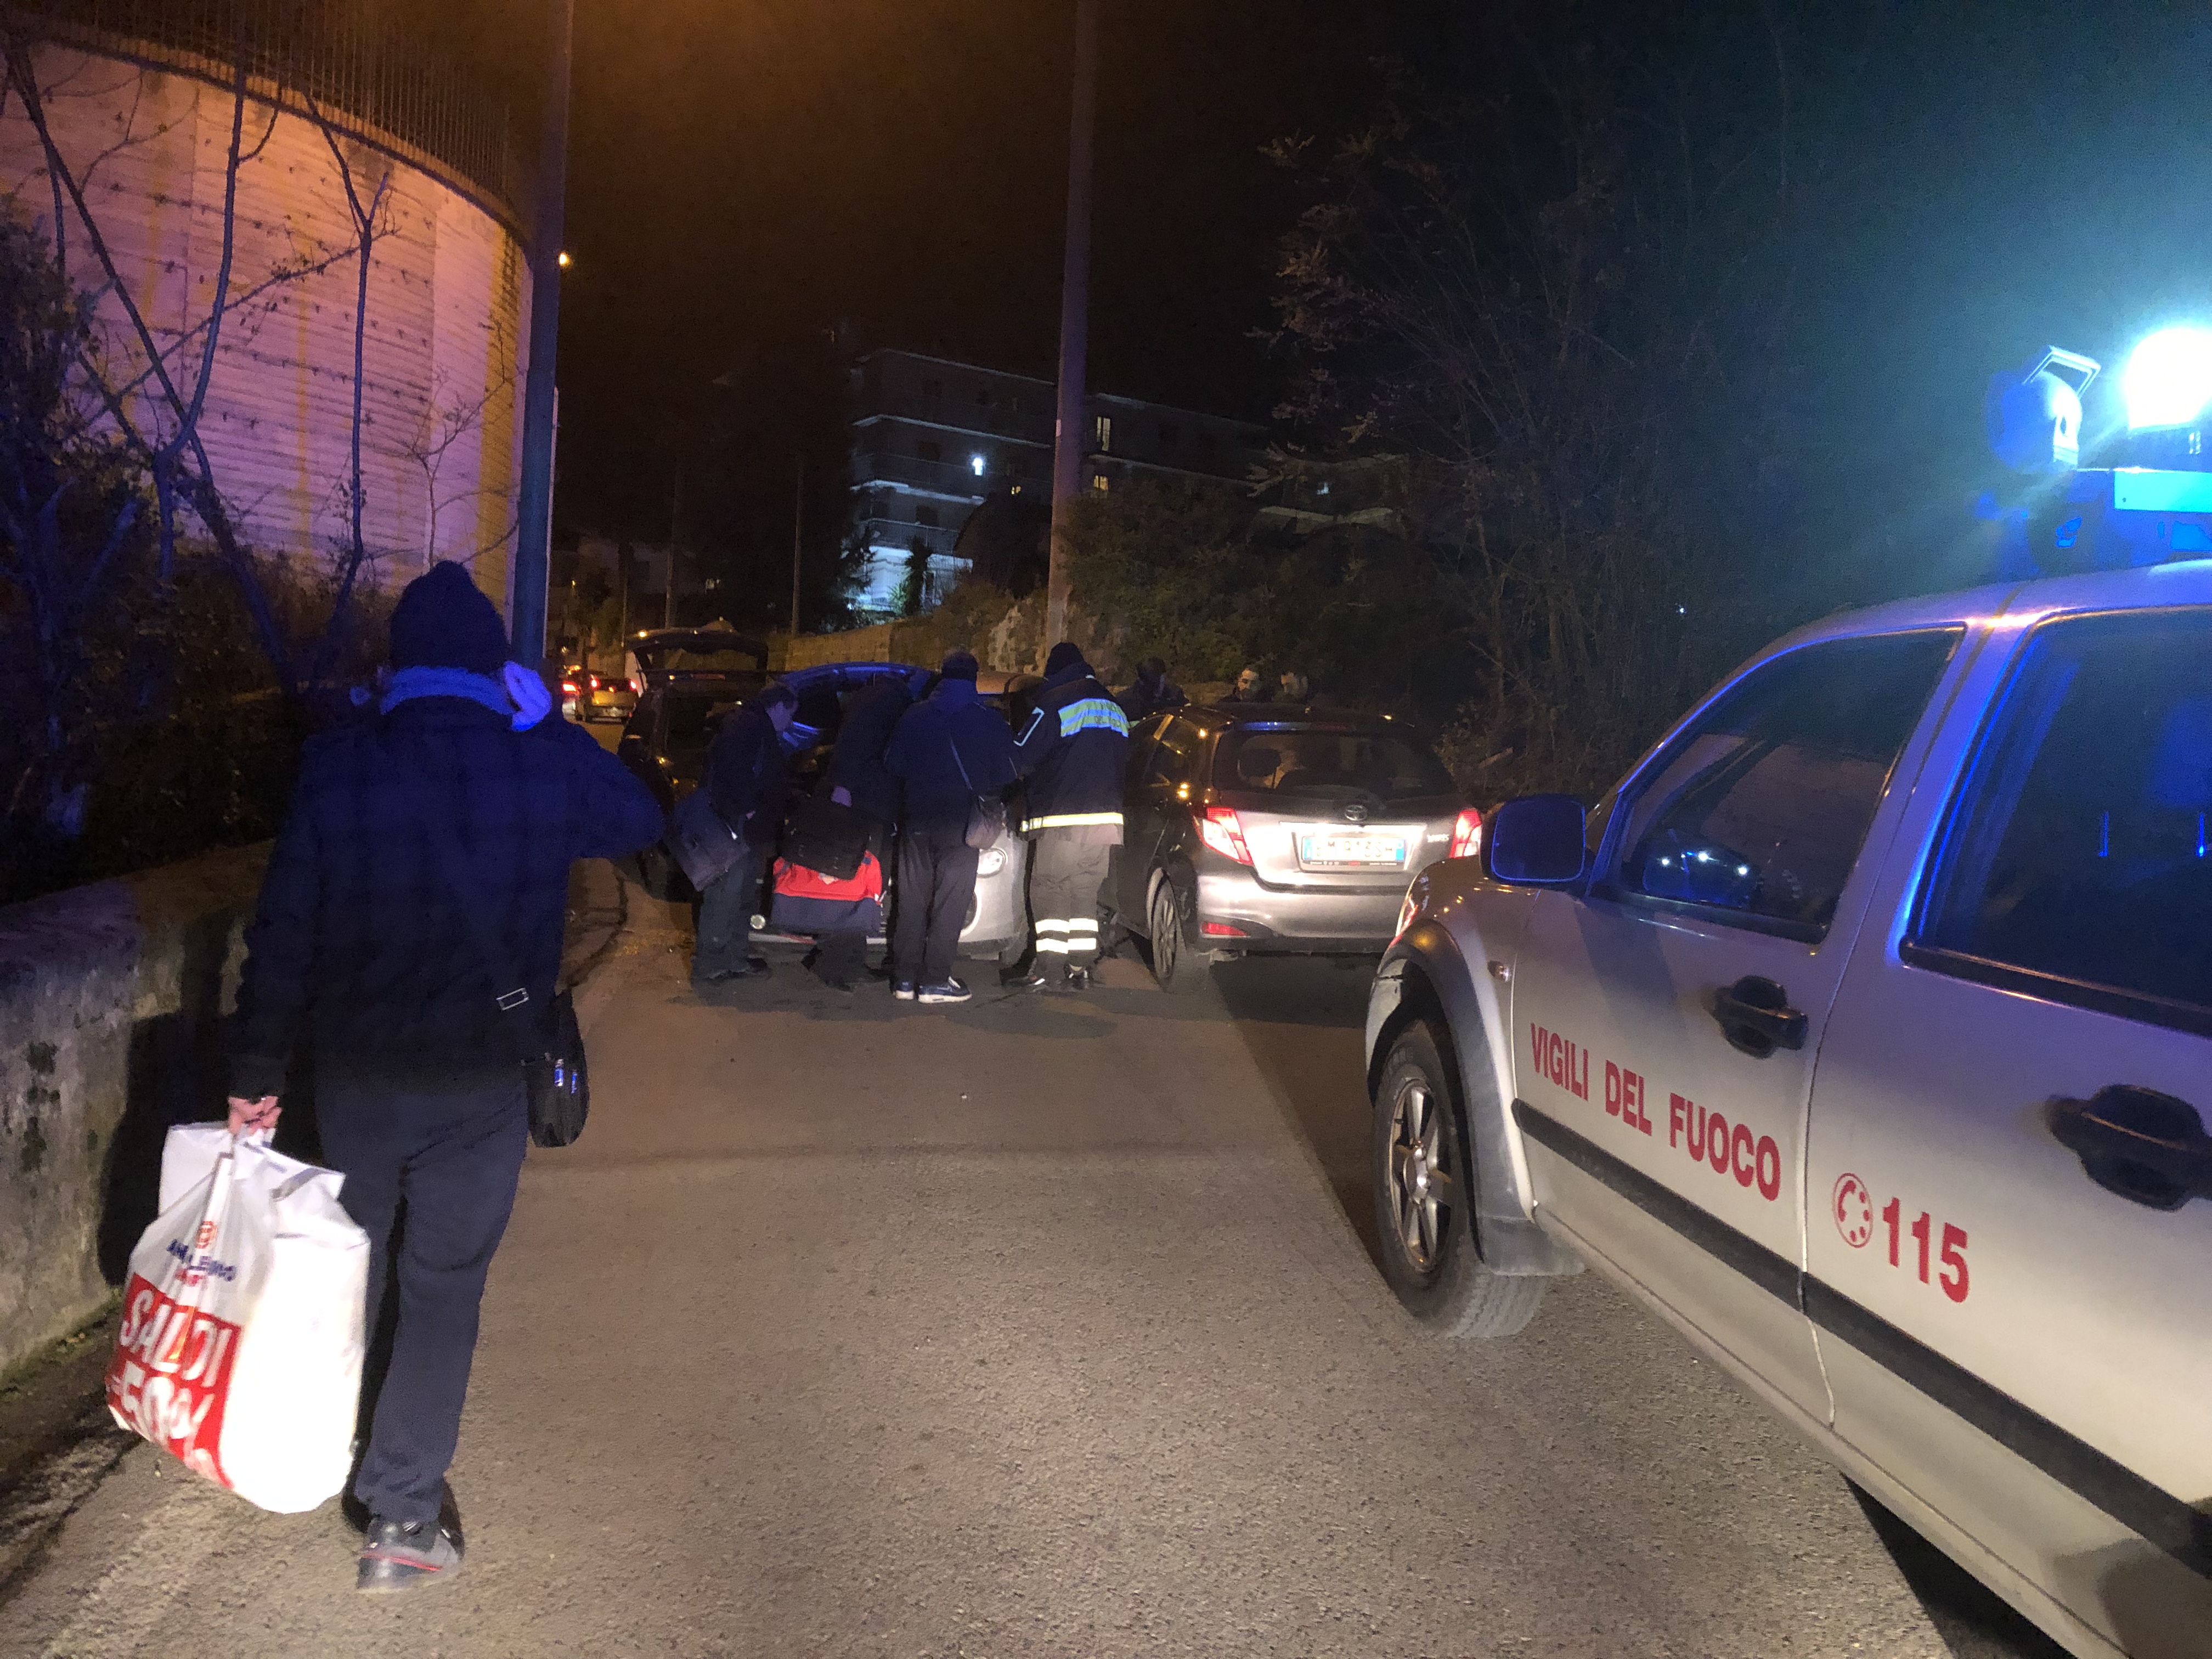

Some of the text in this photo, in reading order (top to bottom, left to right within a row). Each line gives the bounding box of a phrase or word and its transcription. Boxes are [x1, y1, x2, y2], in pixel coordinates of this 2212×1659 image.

[1530, 1023, 1781, 1201] VIGILI DEL FUOCO
[1882, 1197, 1970, 1304] 115
[119, 1288, 233, 1389] SALDI
